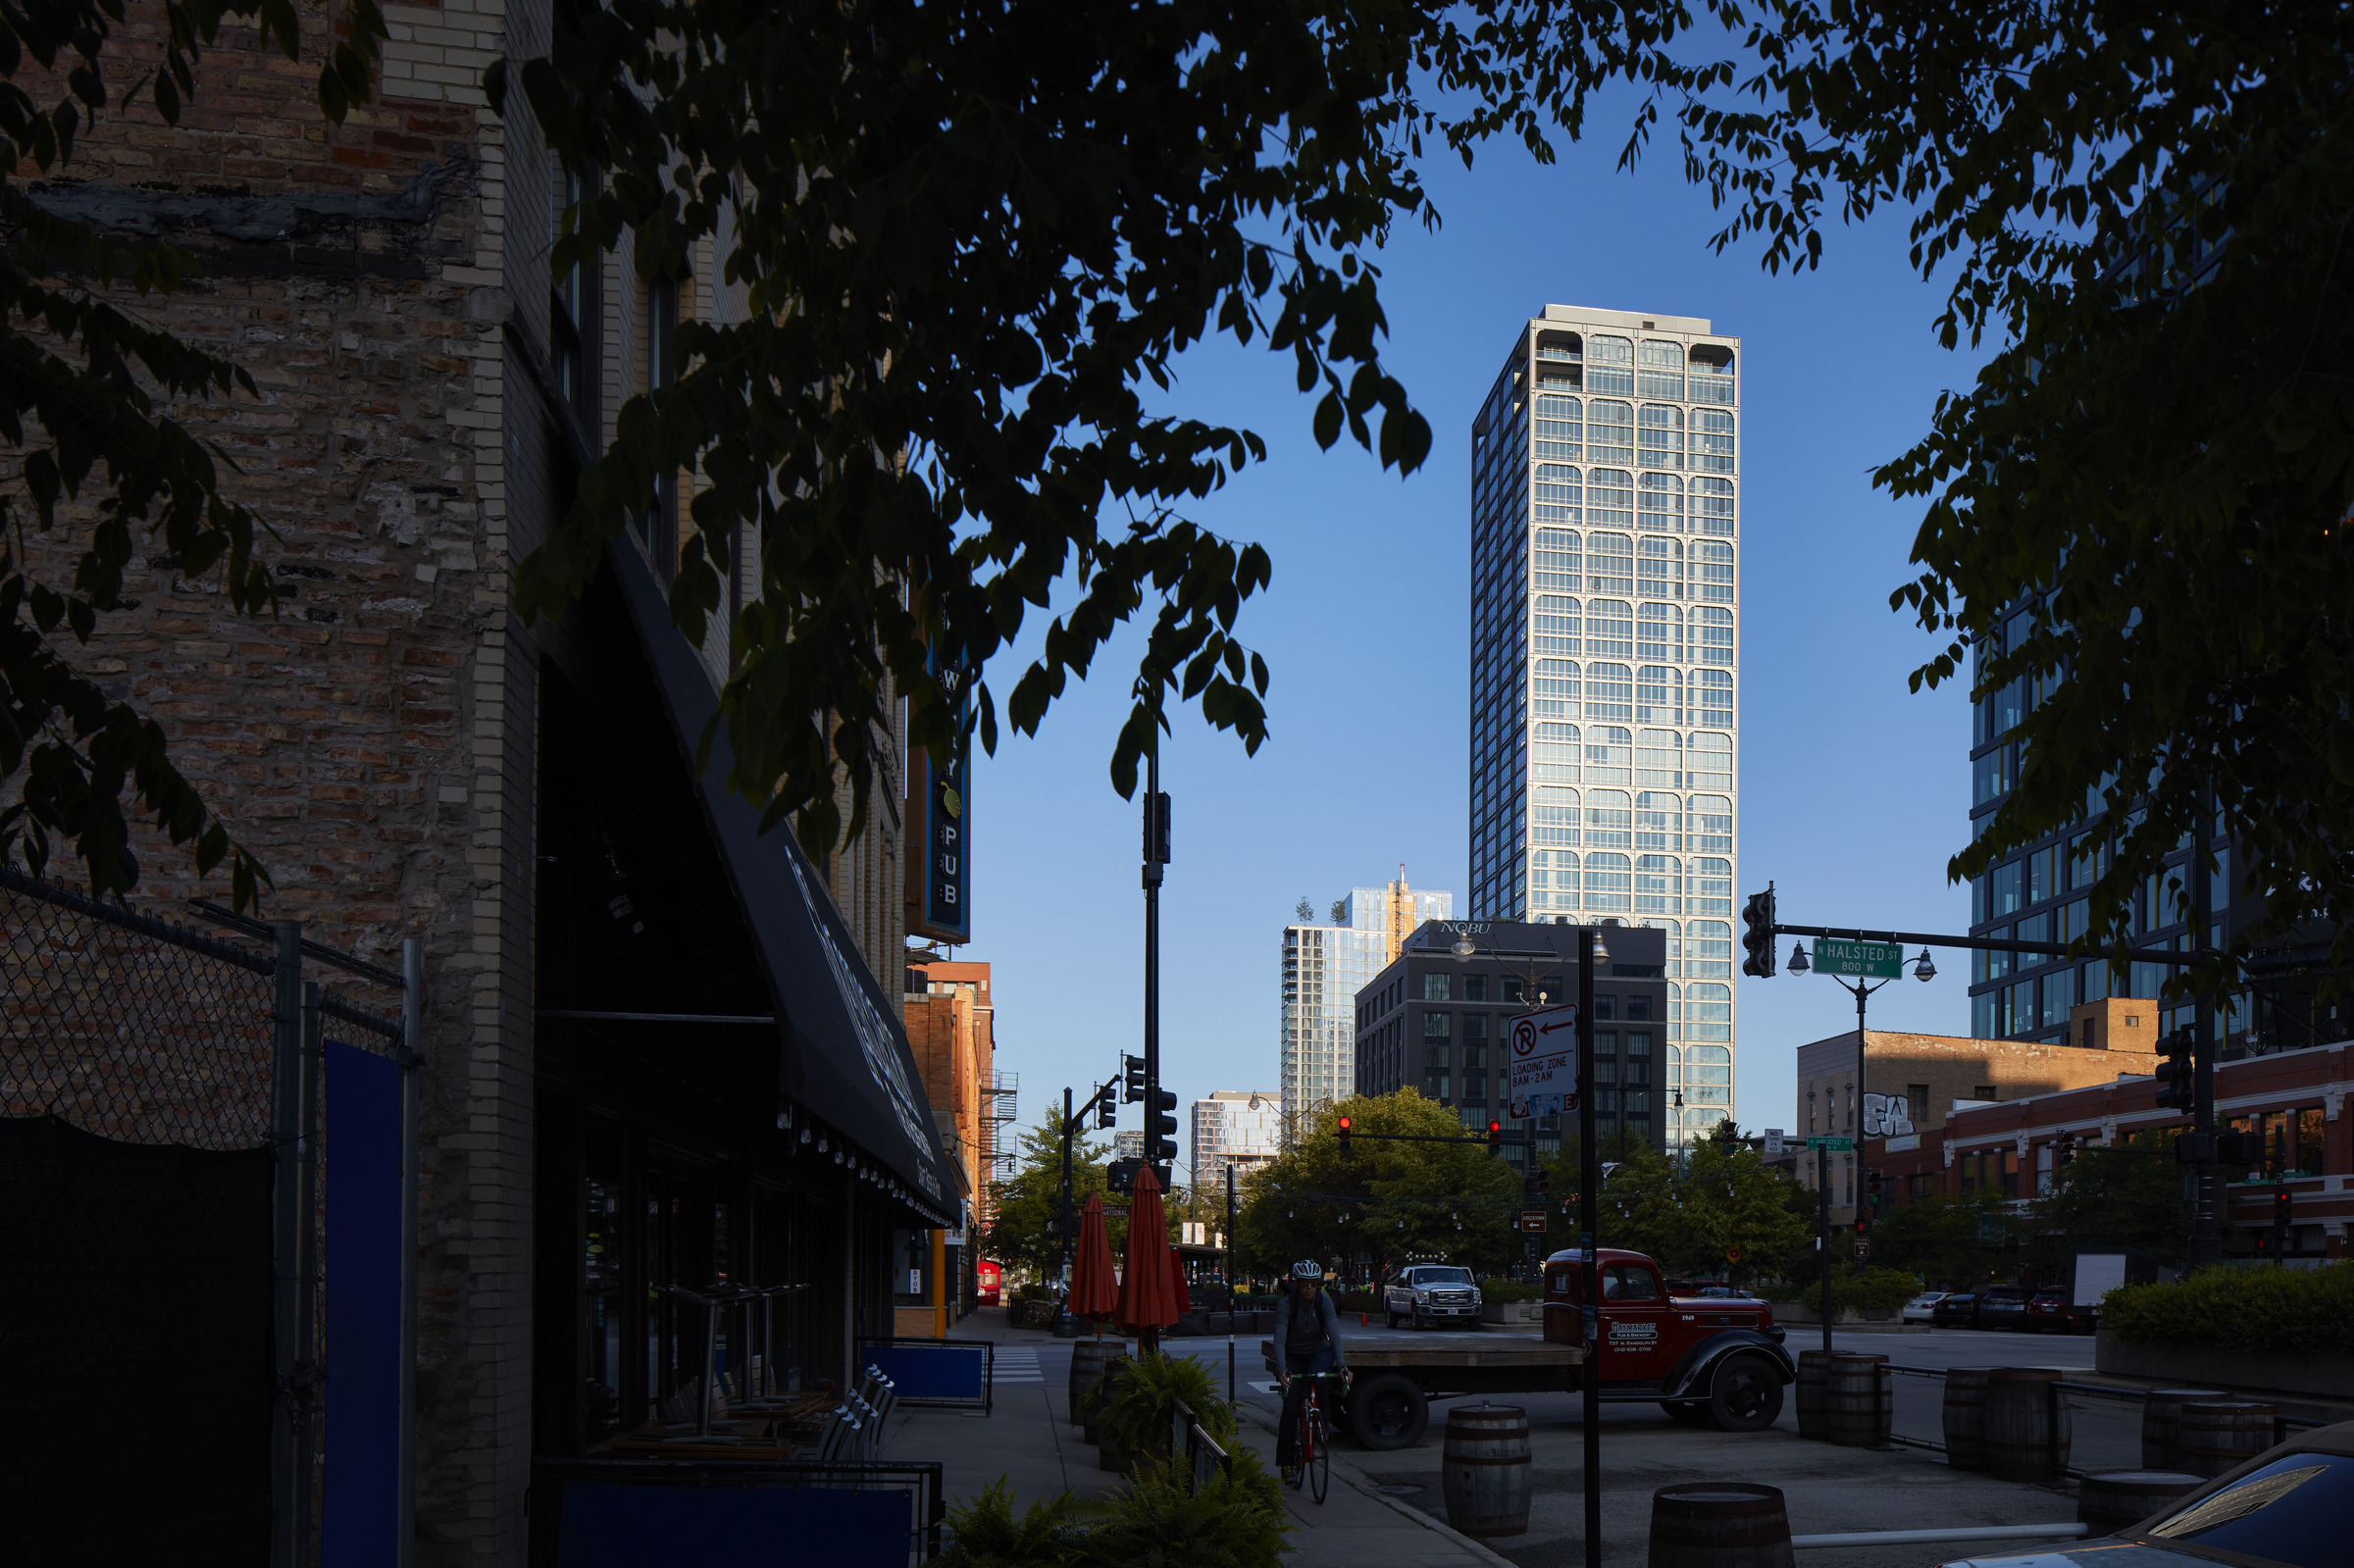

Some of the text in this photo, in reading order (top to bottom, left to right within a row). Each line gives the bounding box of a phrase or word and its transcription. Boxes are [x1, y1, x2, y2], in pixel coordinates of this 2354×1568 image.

[944, 825, 956, 903] PUB
[1440, 922, 1492, 935] NOBU
[1817, 944, 1898, 961] N HALSTED ST
[1841, 961, 1874, 973] 800 W
[1512, 1056, 1567, 1076] LOADING ZONE
